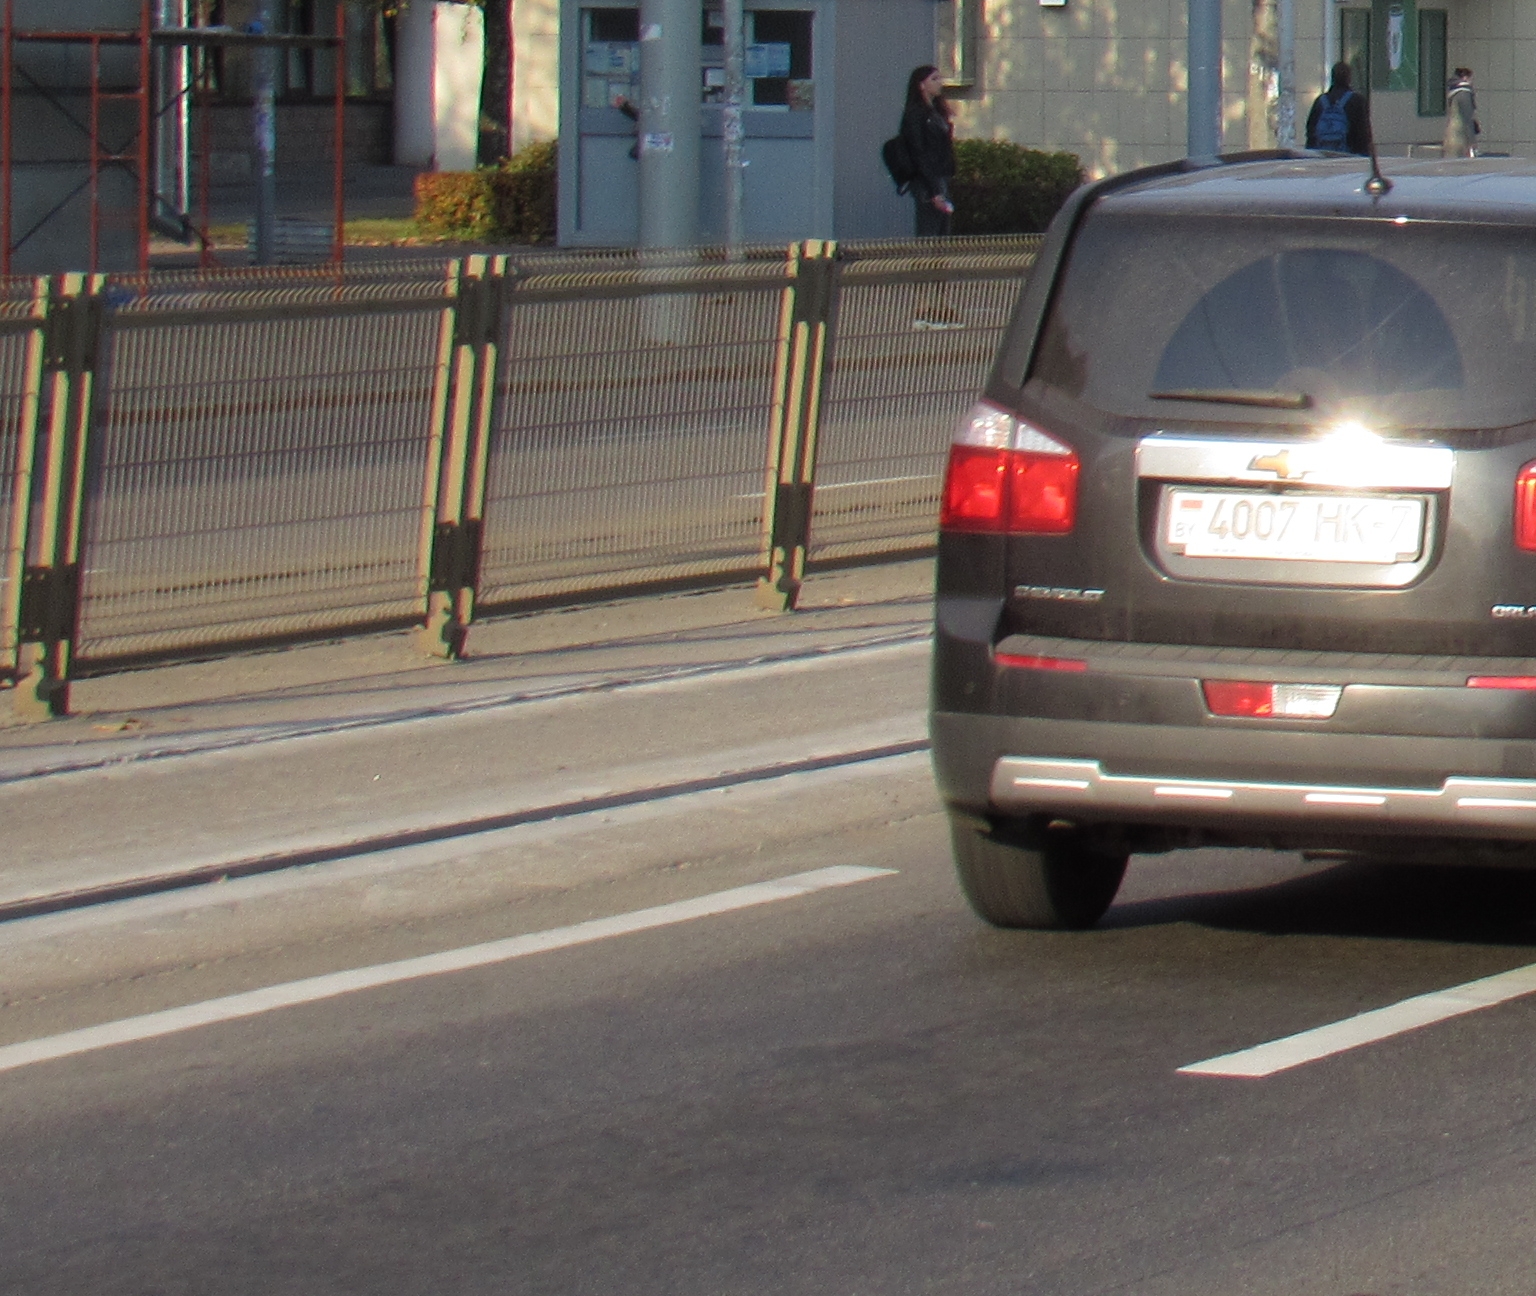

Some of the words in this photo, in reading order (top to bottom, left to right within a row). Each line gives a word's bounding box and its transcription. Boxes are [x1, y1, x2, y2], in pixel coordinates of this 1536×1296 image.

[1174, 520, 1196, 539] BY
[1206, 498, 1301, 541] 4007
[1313, 502, 1413, 544] HK-7
